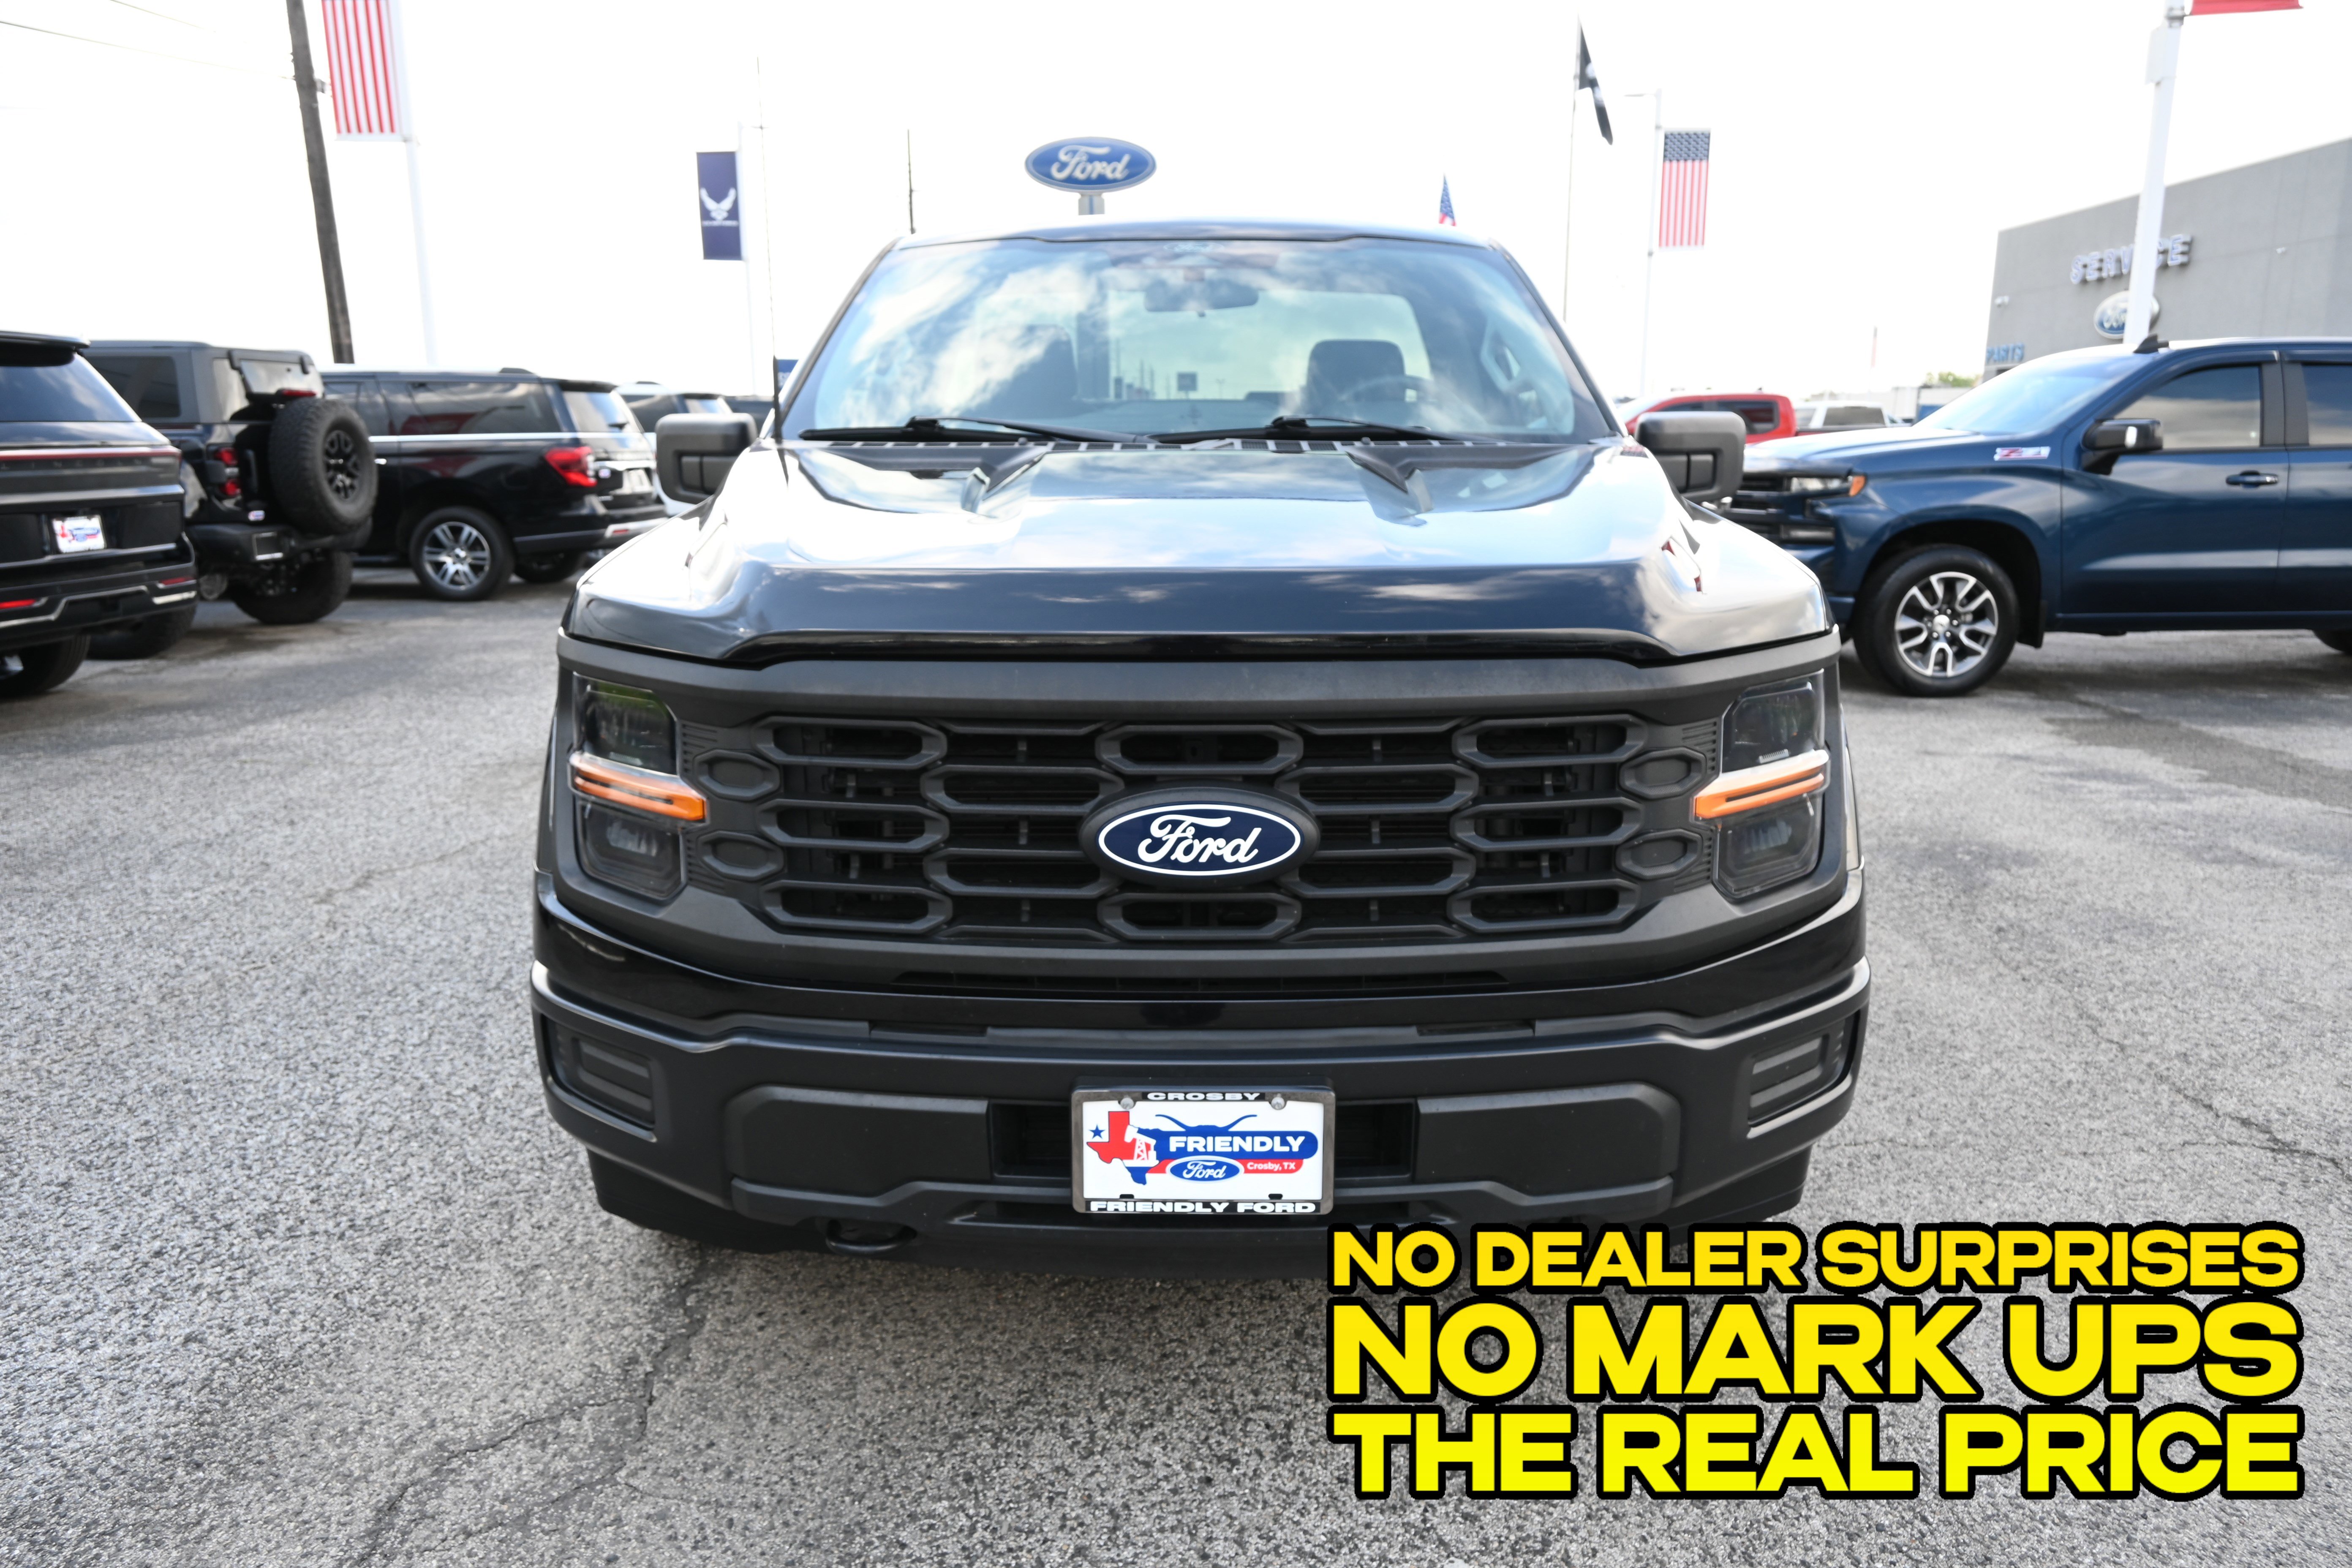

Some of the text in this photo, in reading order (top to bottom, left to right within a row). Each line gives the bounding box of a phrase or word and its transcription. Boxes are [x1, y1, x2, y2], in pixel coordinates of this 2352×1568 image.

[1050, 144, 1131, 180] Ford
[2070, 234, 2189, 284] SERVE
[1986, 343, 2025, 362] PARTS
[1138, 814, 1262, 863] Ford
[1147, 1092, 1260, 1100] CROSBY
[1169, 1136, 1305, 1152] FRIENDLY
[1183, 1161, 1227, 1179] Ford
[1247, 1162, 1282, 1171] Crosby,
[1090, 1201, 1316, 1213] FRIENDLY FORD
